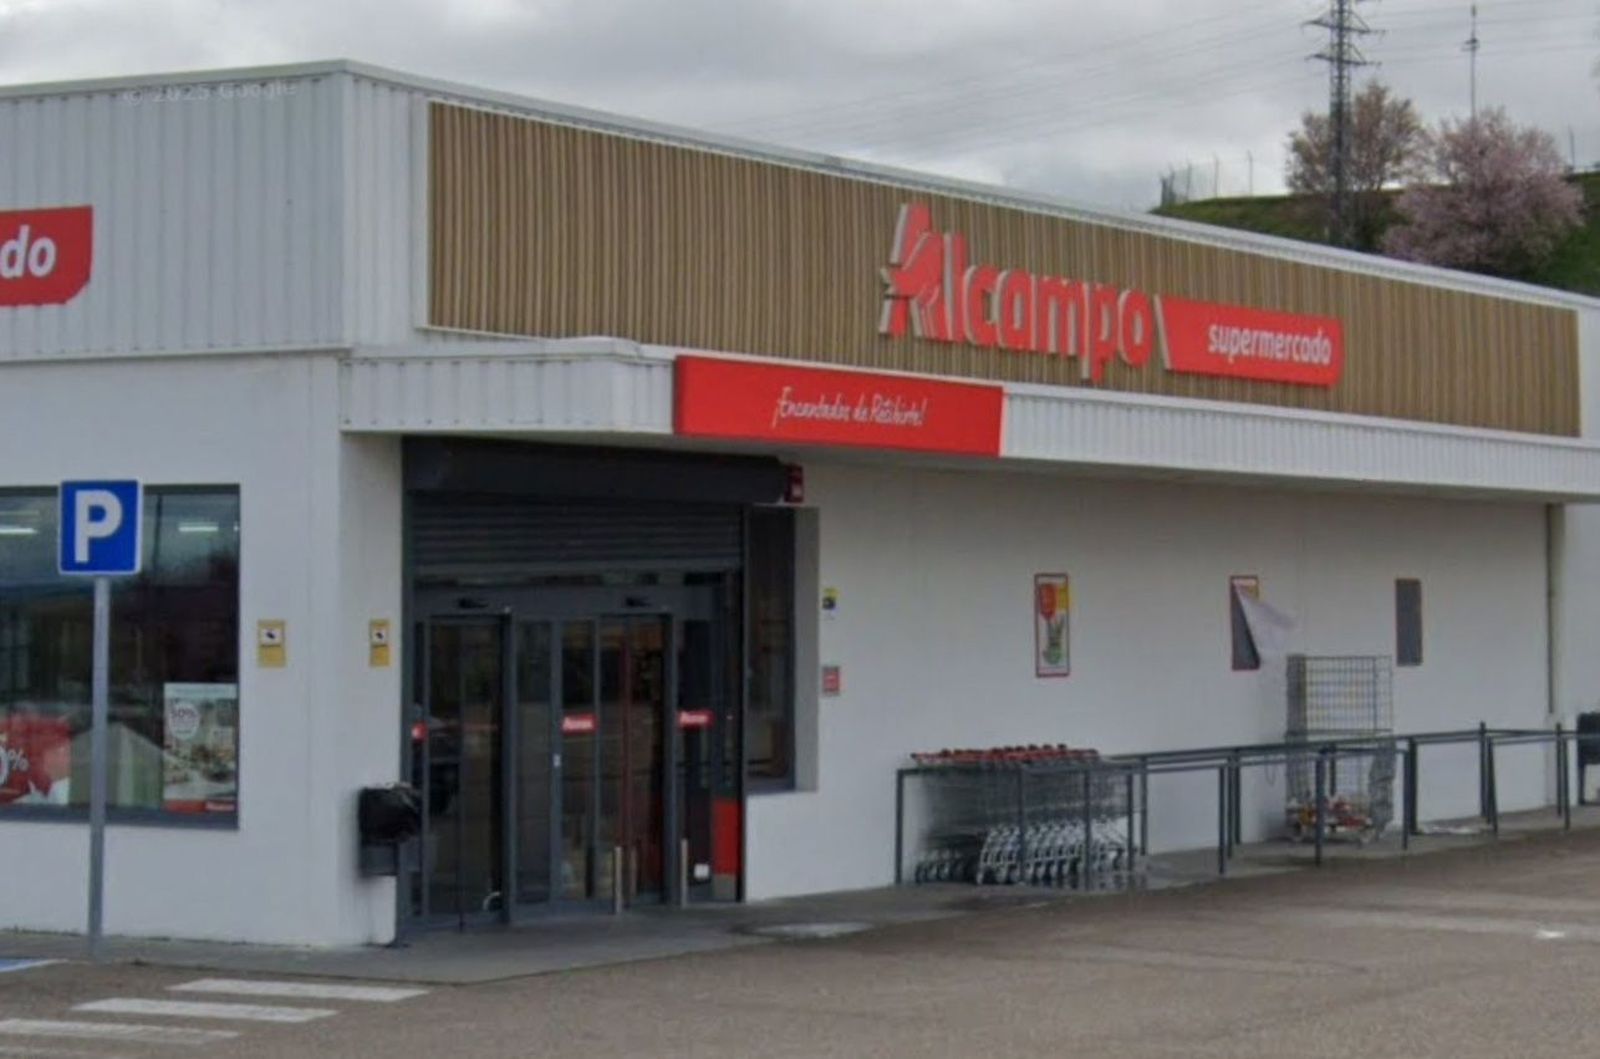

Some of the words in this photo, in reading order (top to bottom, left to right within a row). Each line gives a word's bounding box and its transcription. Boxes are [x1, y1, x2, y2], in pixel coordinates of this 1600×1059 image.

[0, 224, 57, 279] do
[880, 203, 1154, 382] Alcampo
[1207, 324, 1333, 366] supermercado
[854, 392, 869, 423] de
[75, 489, 122, 563] P
